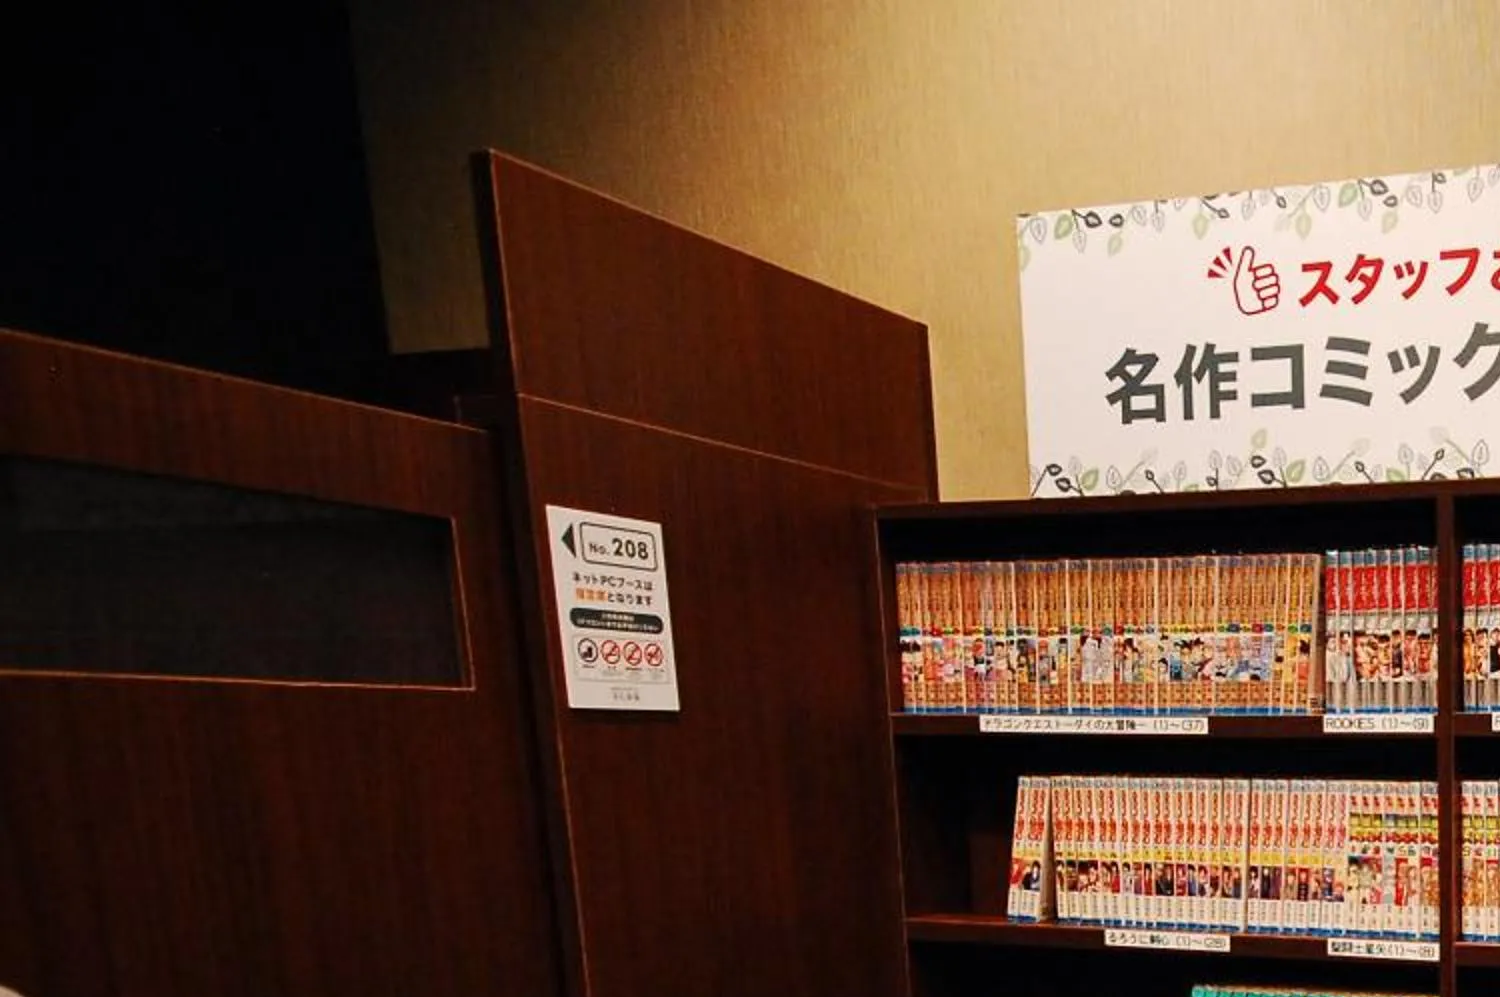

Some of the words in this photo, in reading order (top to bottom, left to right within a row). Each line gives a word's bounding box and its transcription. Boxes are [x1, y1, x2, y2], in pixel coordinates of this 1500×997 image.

[589, 543, 611, 557] No.
[612, 537, 650, 561] 208
[1325, 717, 1376, 730] ROOKIES
